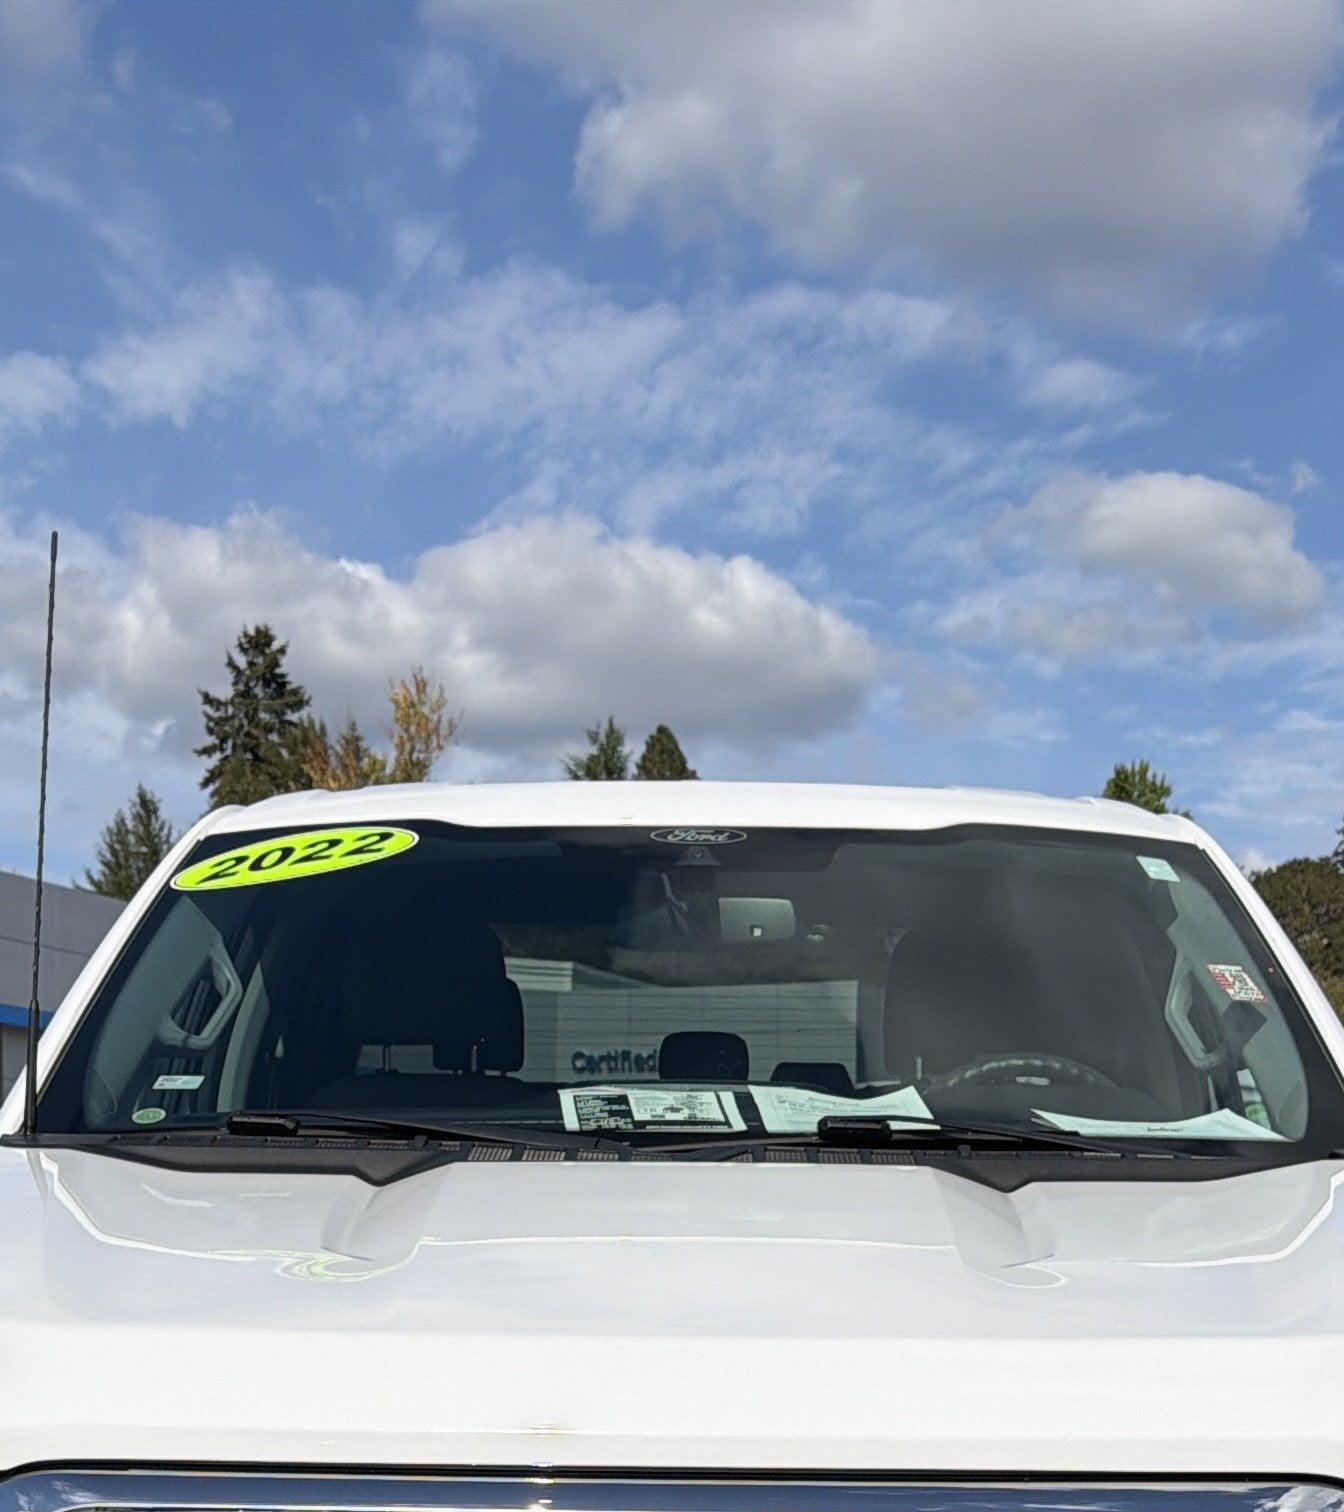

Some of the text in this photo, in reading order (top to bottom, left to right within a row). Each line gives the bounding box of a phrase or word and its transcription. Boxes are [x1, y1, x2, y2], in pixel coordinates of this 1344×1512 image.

[666, 829, 731, 842] Ford
[195, 831, 395, 886] 2022
[570, 1048, 660, 1075] Certified
